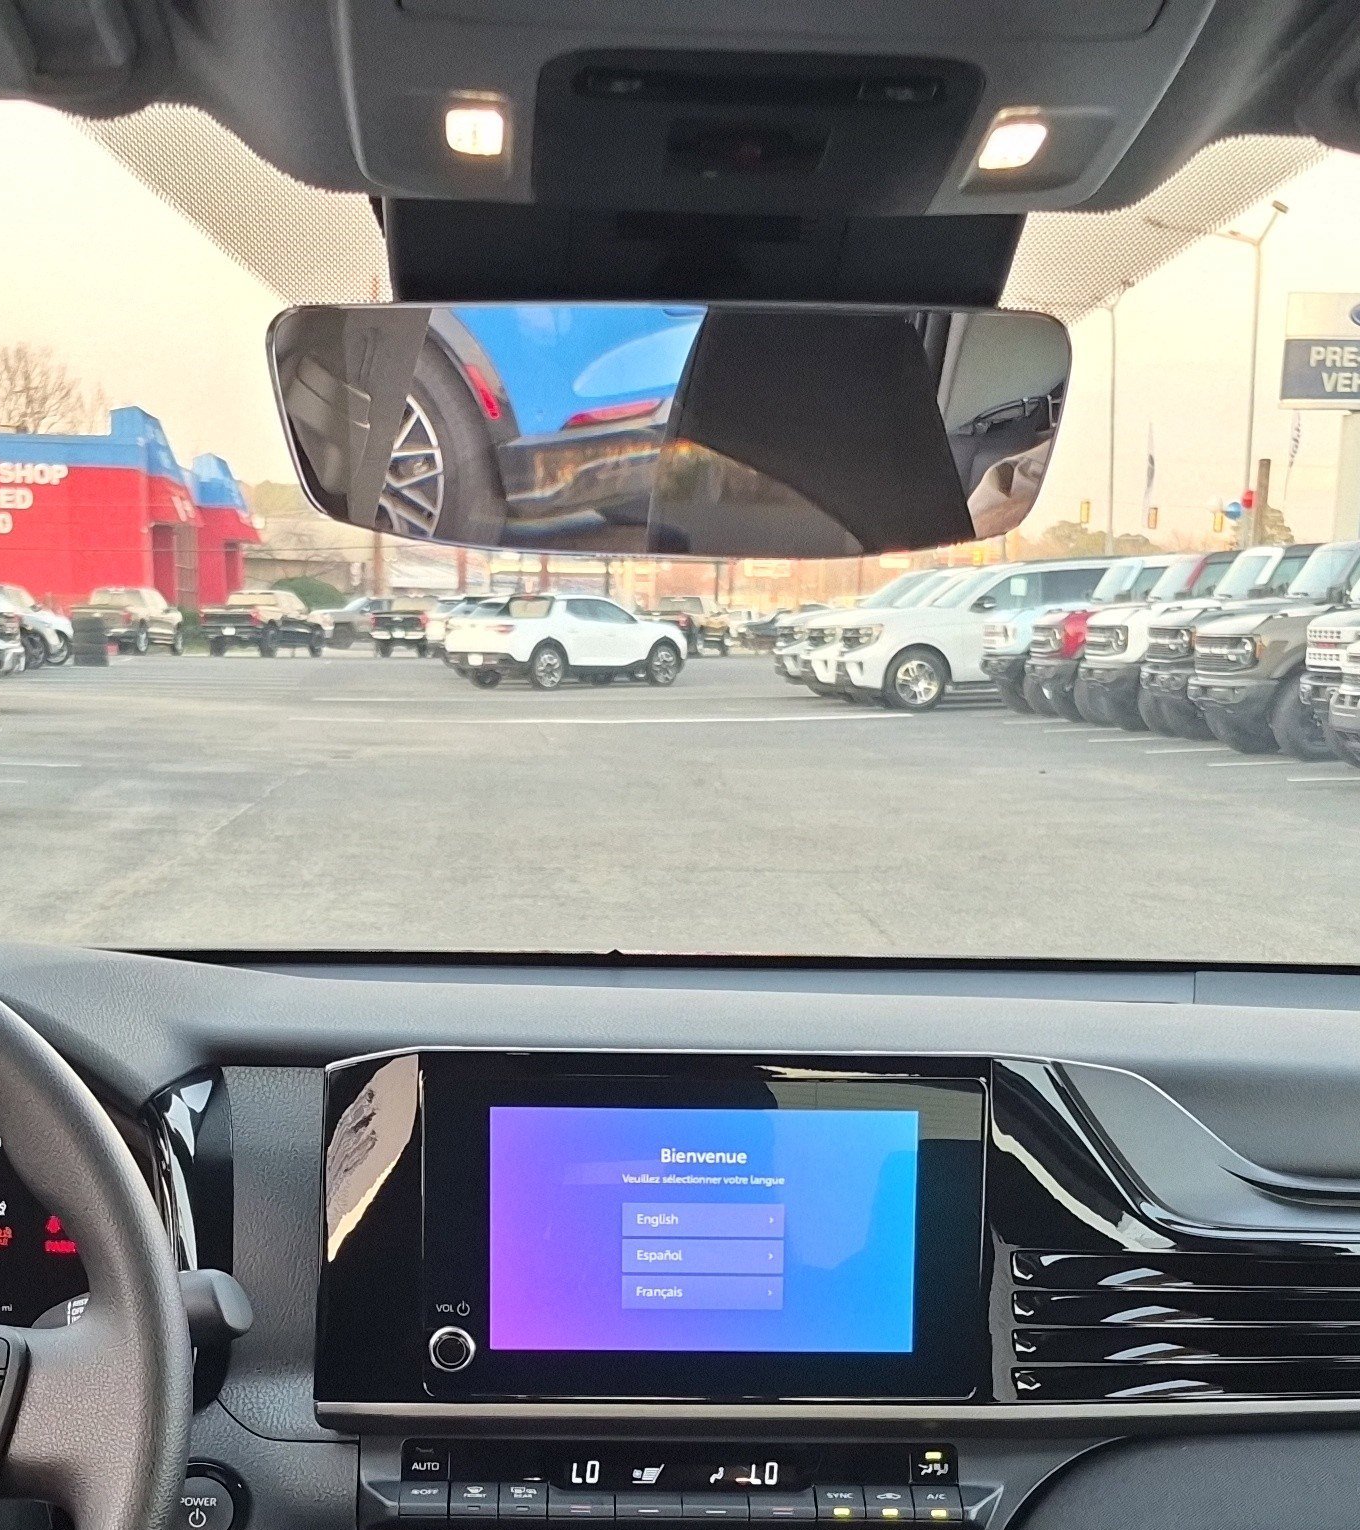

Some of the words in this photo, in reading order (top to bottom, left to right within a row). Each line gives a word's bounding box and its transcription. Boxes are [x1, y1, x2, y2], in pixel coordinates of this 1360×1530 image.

[660, 1148, 748, 1164] Bienvenue
[621, 1174, 660, 1184] Veuillez
[662, 1174, 722, 1185] sélectionner
[723, 1176, 749, 1185] votre
[750, 1175, 785, 1187] langue
[636, 1213, 679, 1227] English
[636, 1249, 682, 1263] Español
[636, 1286, 683, 1300] Français
[1, 1303, 13, 1312] mi
[435, 1303, 455, 1313] VOL
[411, 1461, 440, 1471] AUTO
[571, 1460, 600, 1484] LO
[826, 1491, 854, 1500] SYNC
[926, 1492, 946, 1501] A/C
